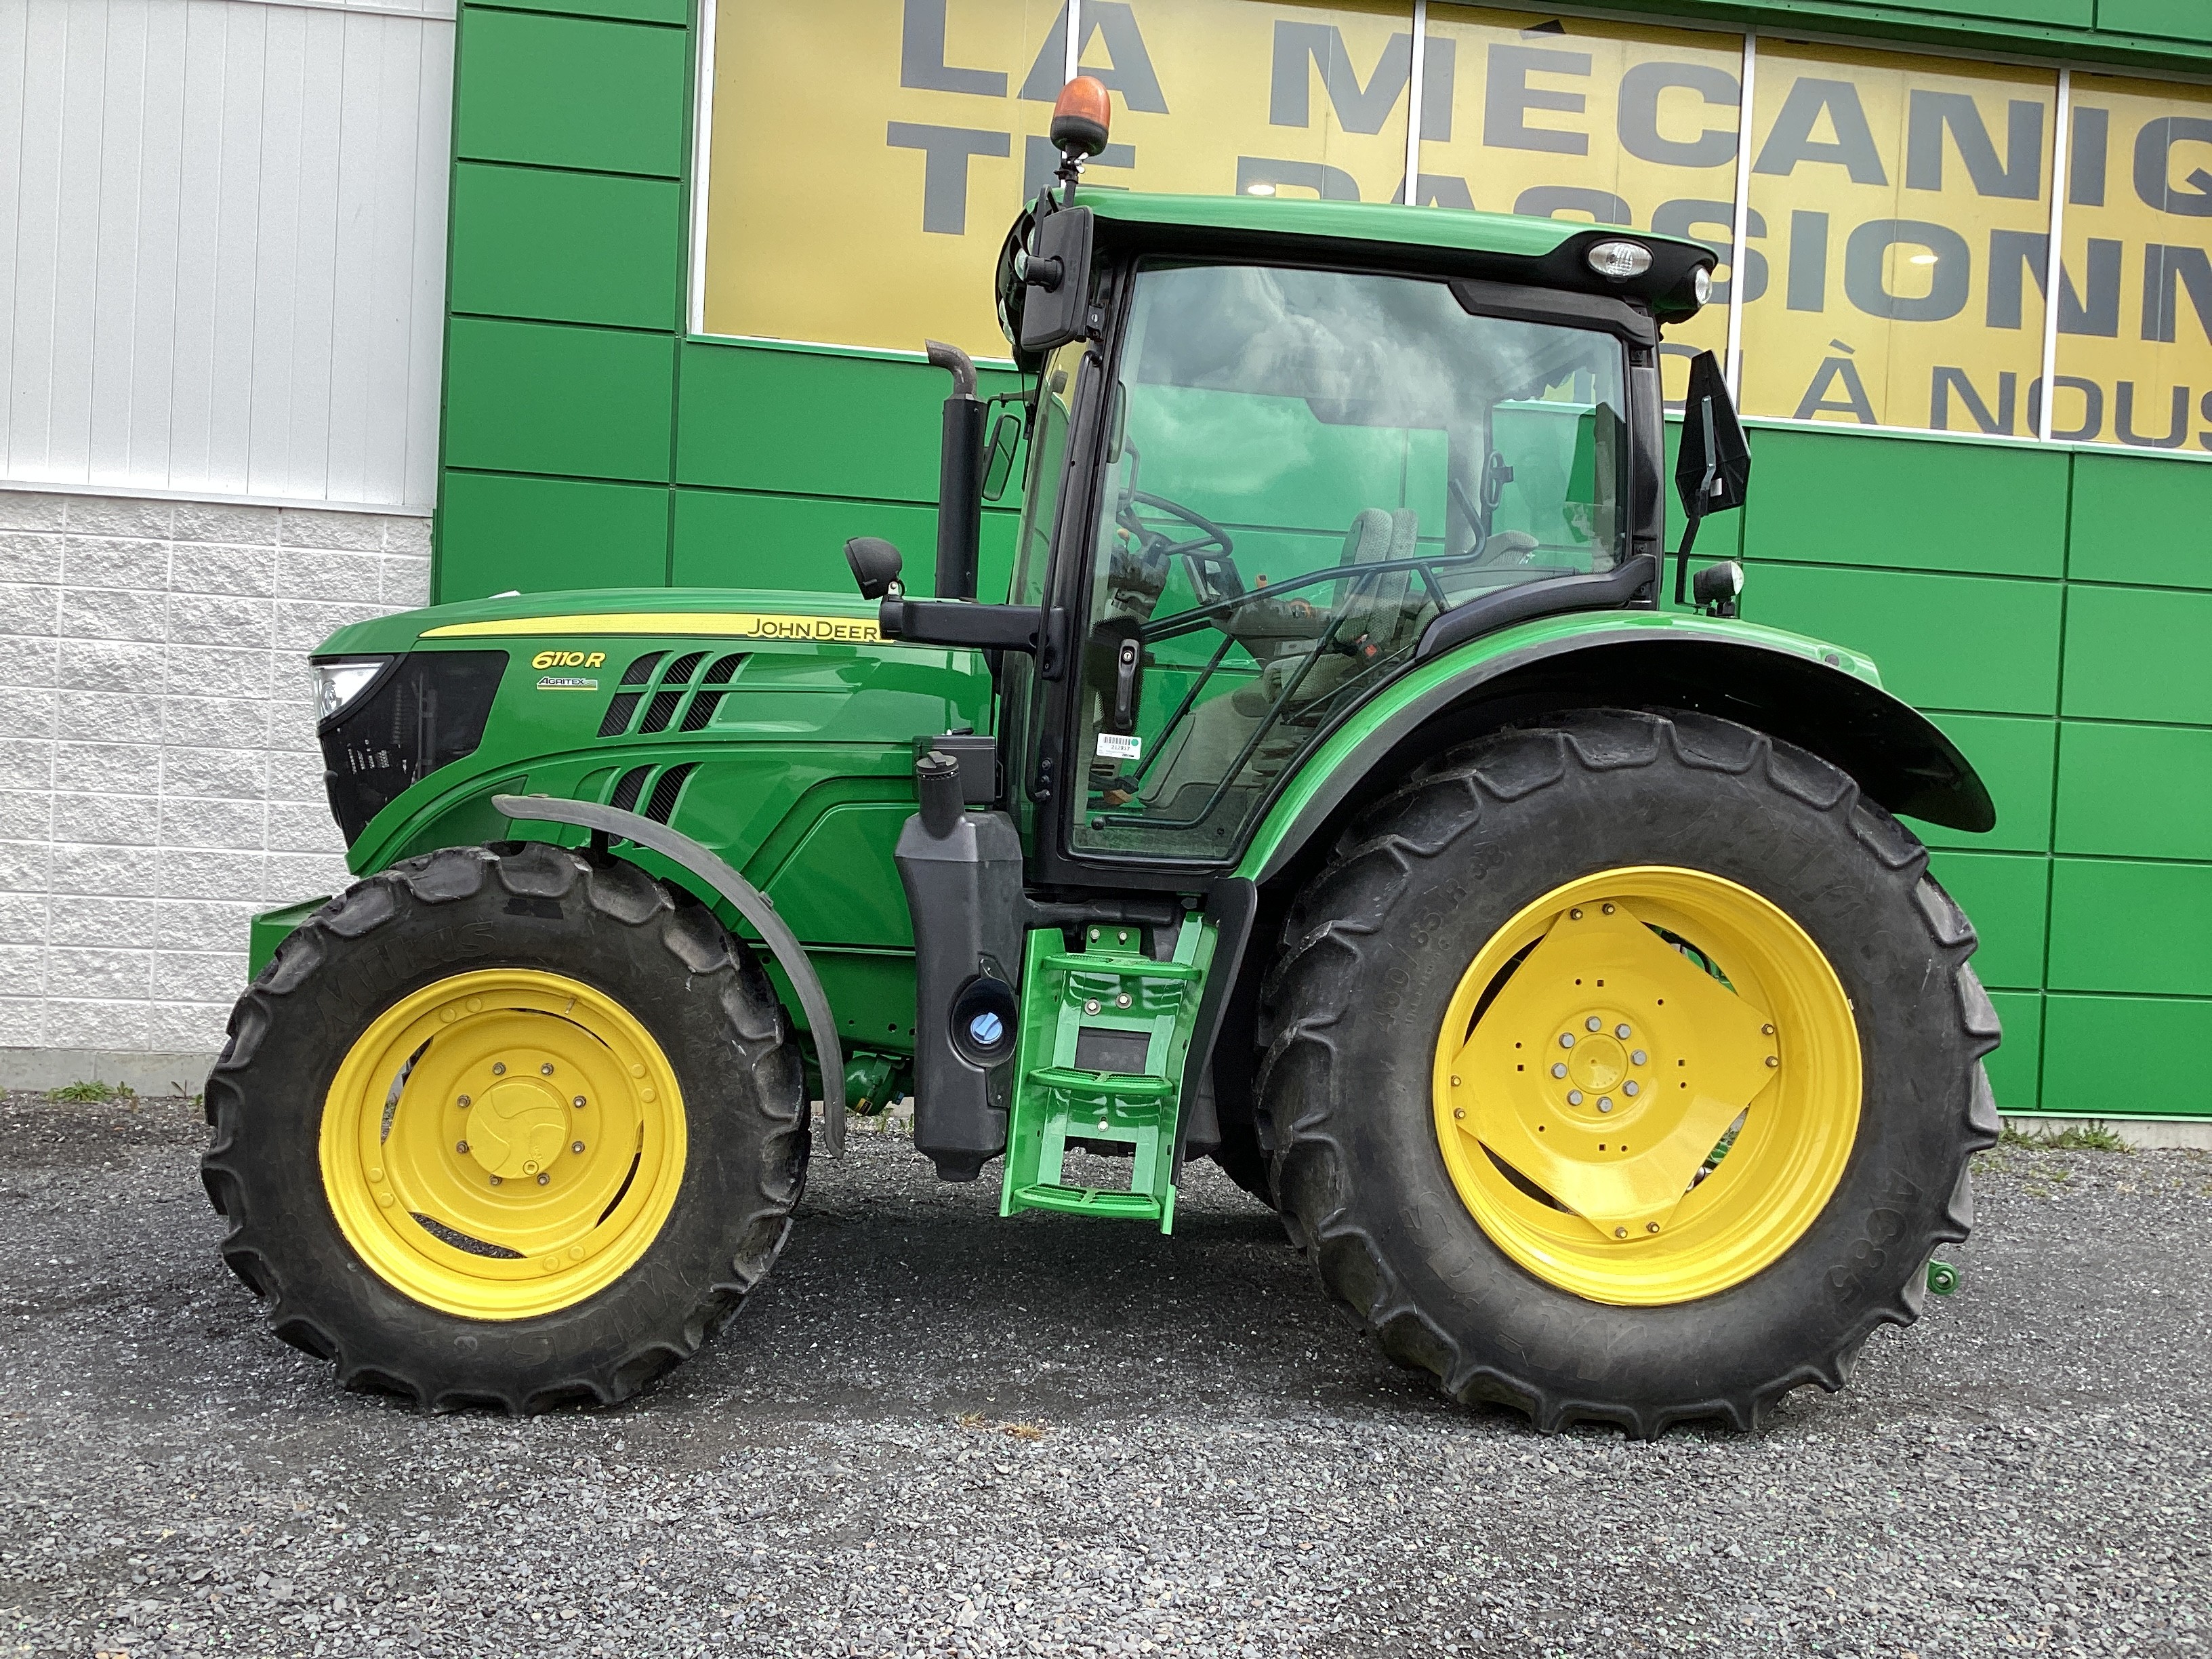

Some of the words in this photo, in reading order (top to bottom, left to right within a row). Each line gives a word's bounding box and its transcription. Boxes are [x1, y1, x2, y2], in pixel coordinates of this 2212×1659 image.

[901, 0, 1170, 115] LA
[1931, 367, 2212, 452] NOU
[747, 618, 811, 637] JOHN
[816, 621, 881, 640] DEER
